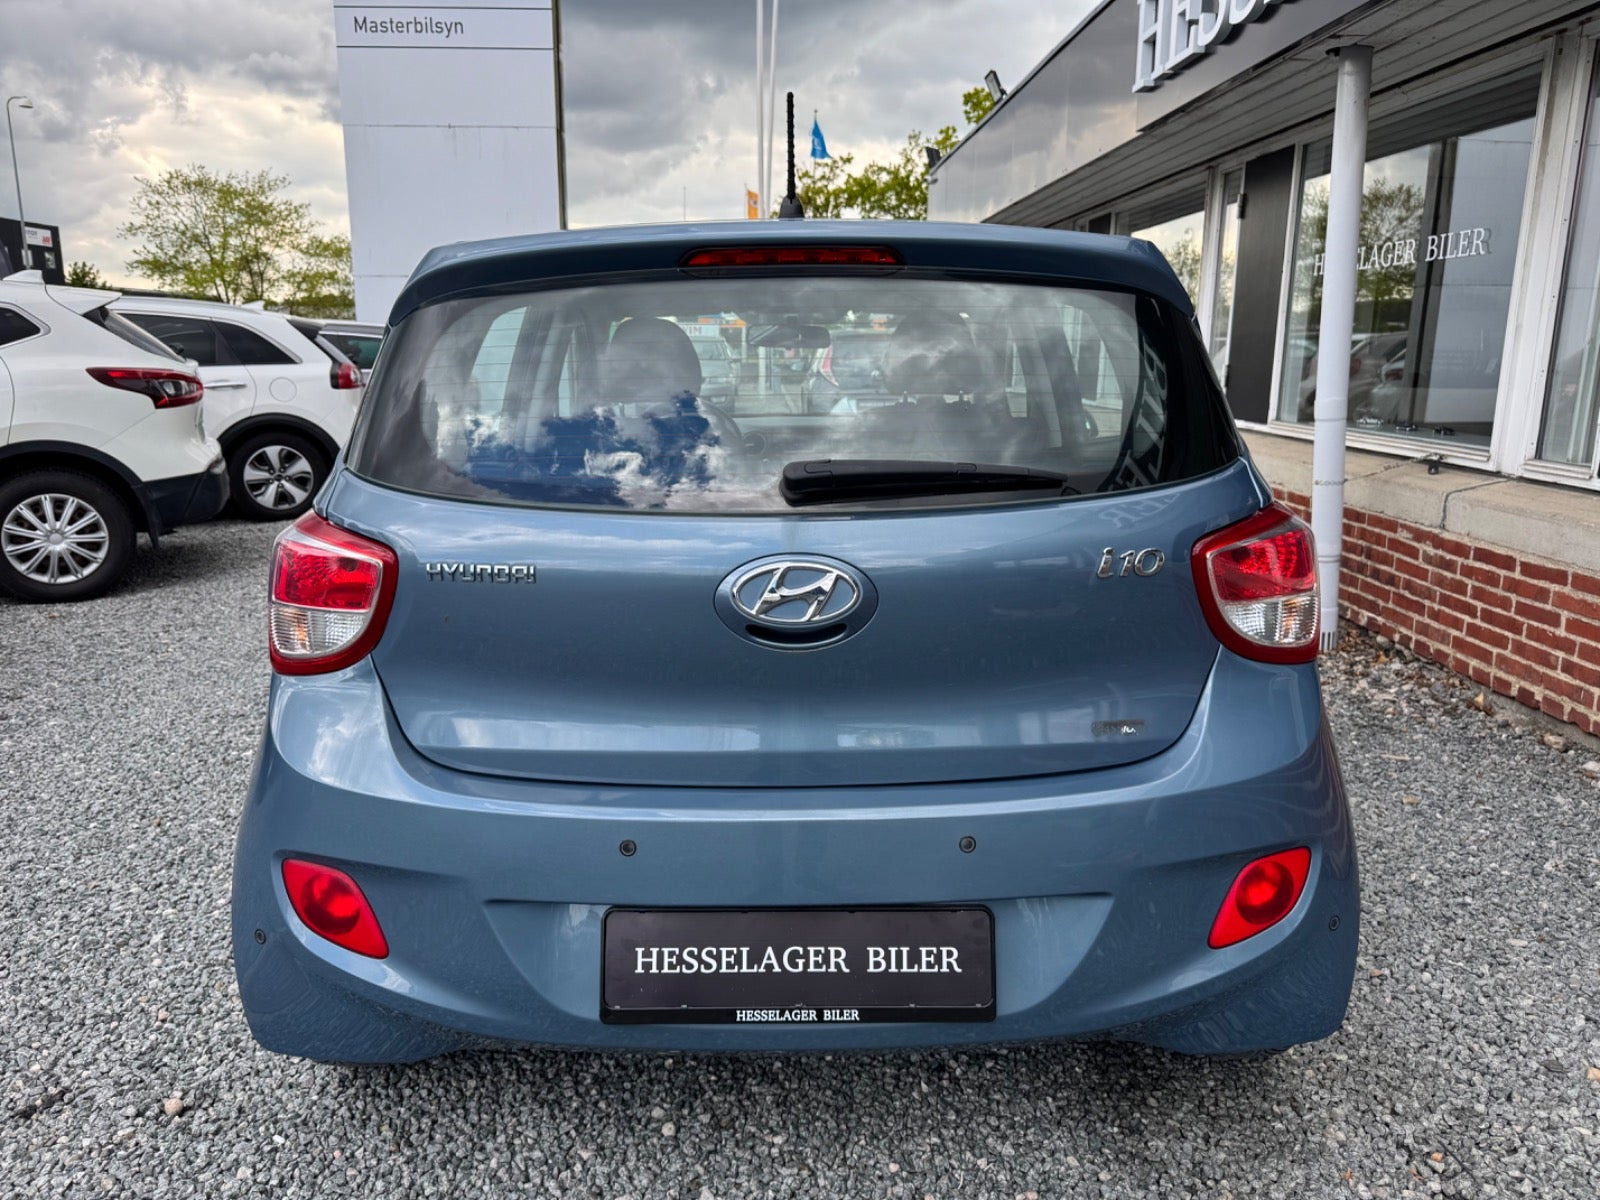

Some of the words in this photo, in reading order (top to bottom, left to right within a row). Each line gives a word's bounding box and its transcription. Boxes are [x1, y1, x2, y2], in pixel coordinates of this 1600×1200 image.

[353, 15, 465, 39] Masterbilsyn
[1424, 227, 1486, 262] BILER
[425, 562, 537, 584] HYUNDAI
[634, 946, 850, 973] HESSELAGER
[866, 946, 962, 973] BILER
[735, 1009, 818, 1022] HESSELAGER
[823, 1009, 860, 1021] BILER
